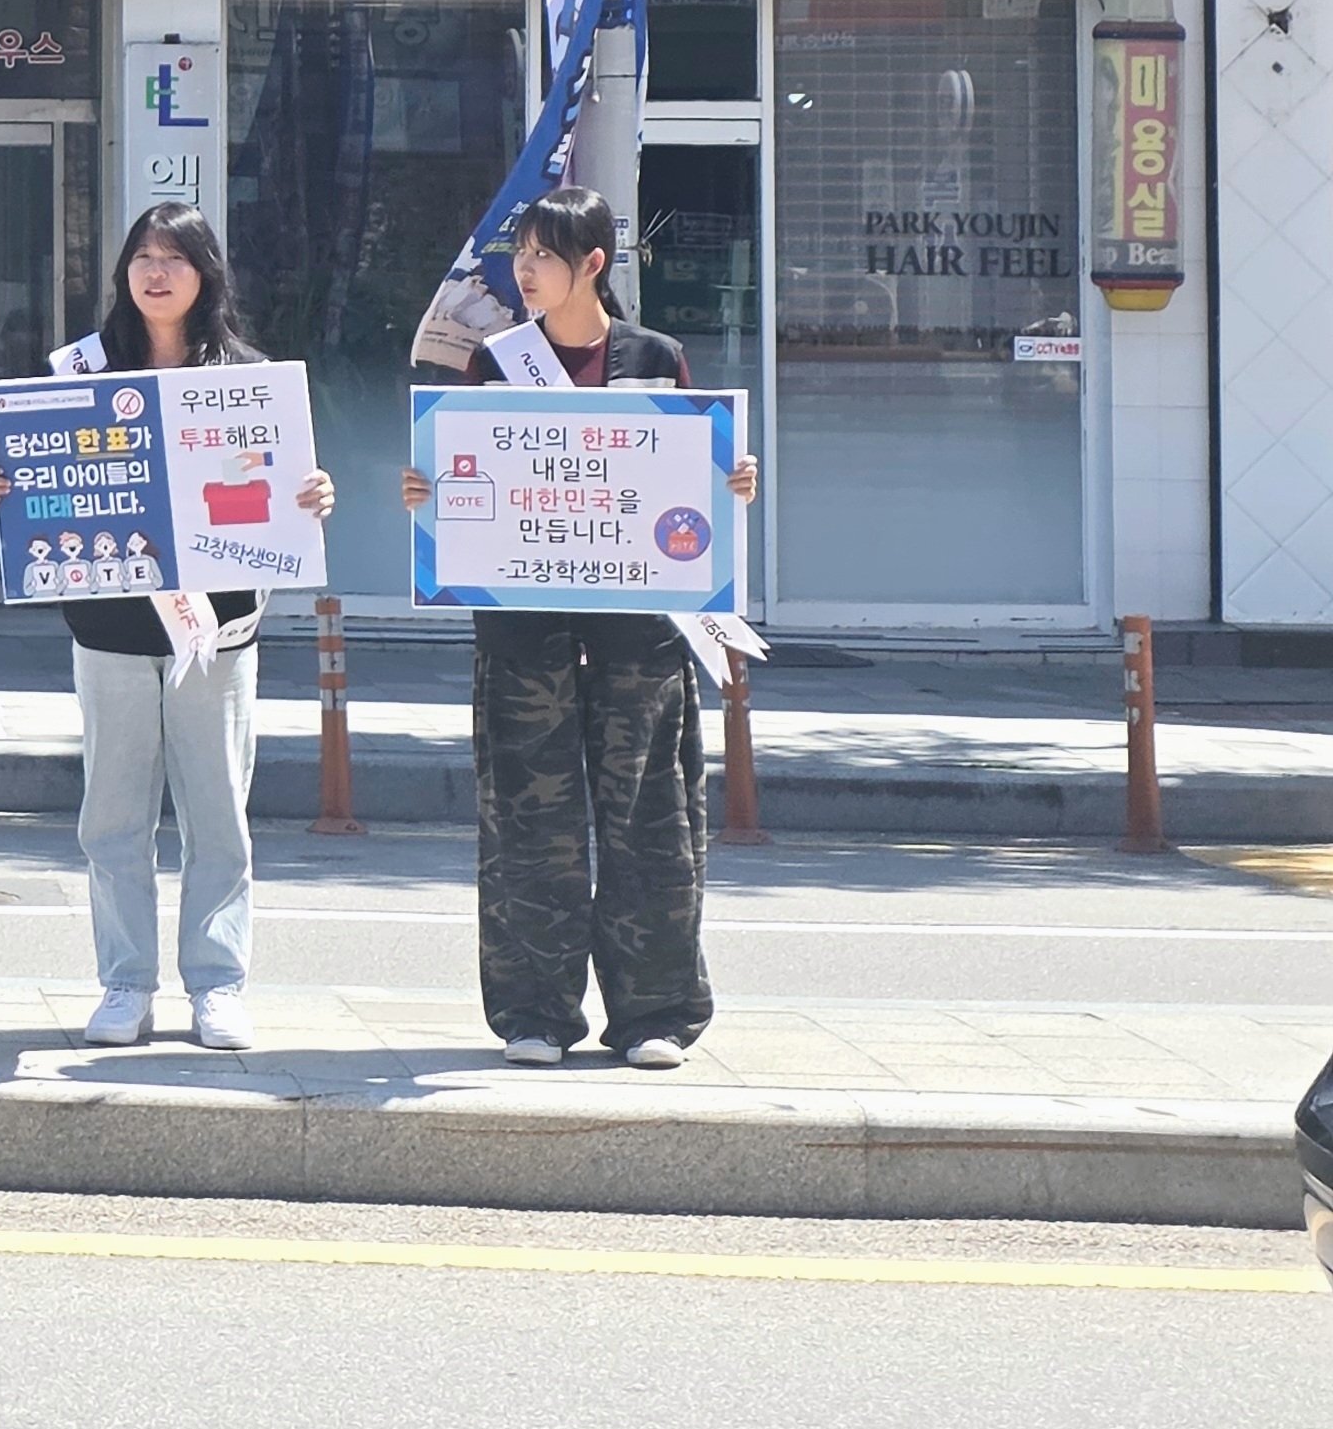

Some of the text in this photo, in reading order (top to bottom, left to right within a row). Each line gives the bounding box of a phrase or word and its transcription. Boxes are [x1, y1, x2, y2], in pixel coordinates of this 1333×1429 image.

[1126, 55, 1169, 239] 미용실
[865, 212, 1061, 240] PARK YOUJIN
[865, 245, 1074, 278] HAIR FEEL
[180, 384, 273, 413] 우리모두
[5, 426, 152, 458] 당신의 한 표가
[178, 424, 281, 452] 투표해요!
[492, 425, 660, 454] 당신의 한표가
[14, 460, 151, 491] 우리 아이들의
[532, 457, 608, 483] 내일의
[25, 491, 146, 520] 미래입니다.
[446, 496, 484, 507] VOTE
[510, 487, 642, 515] 대한민국을
[519, 519, 632, 546] 만듭니다.
[189, 534, 303, 578] 고창학생의회
